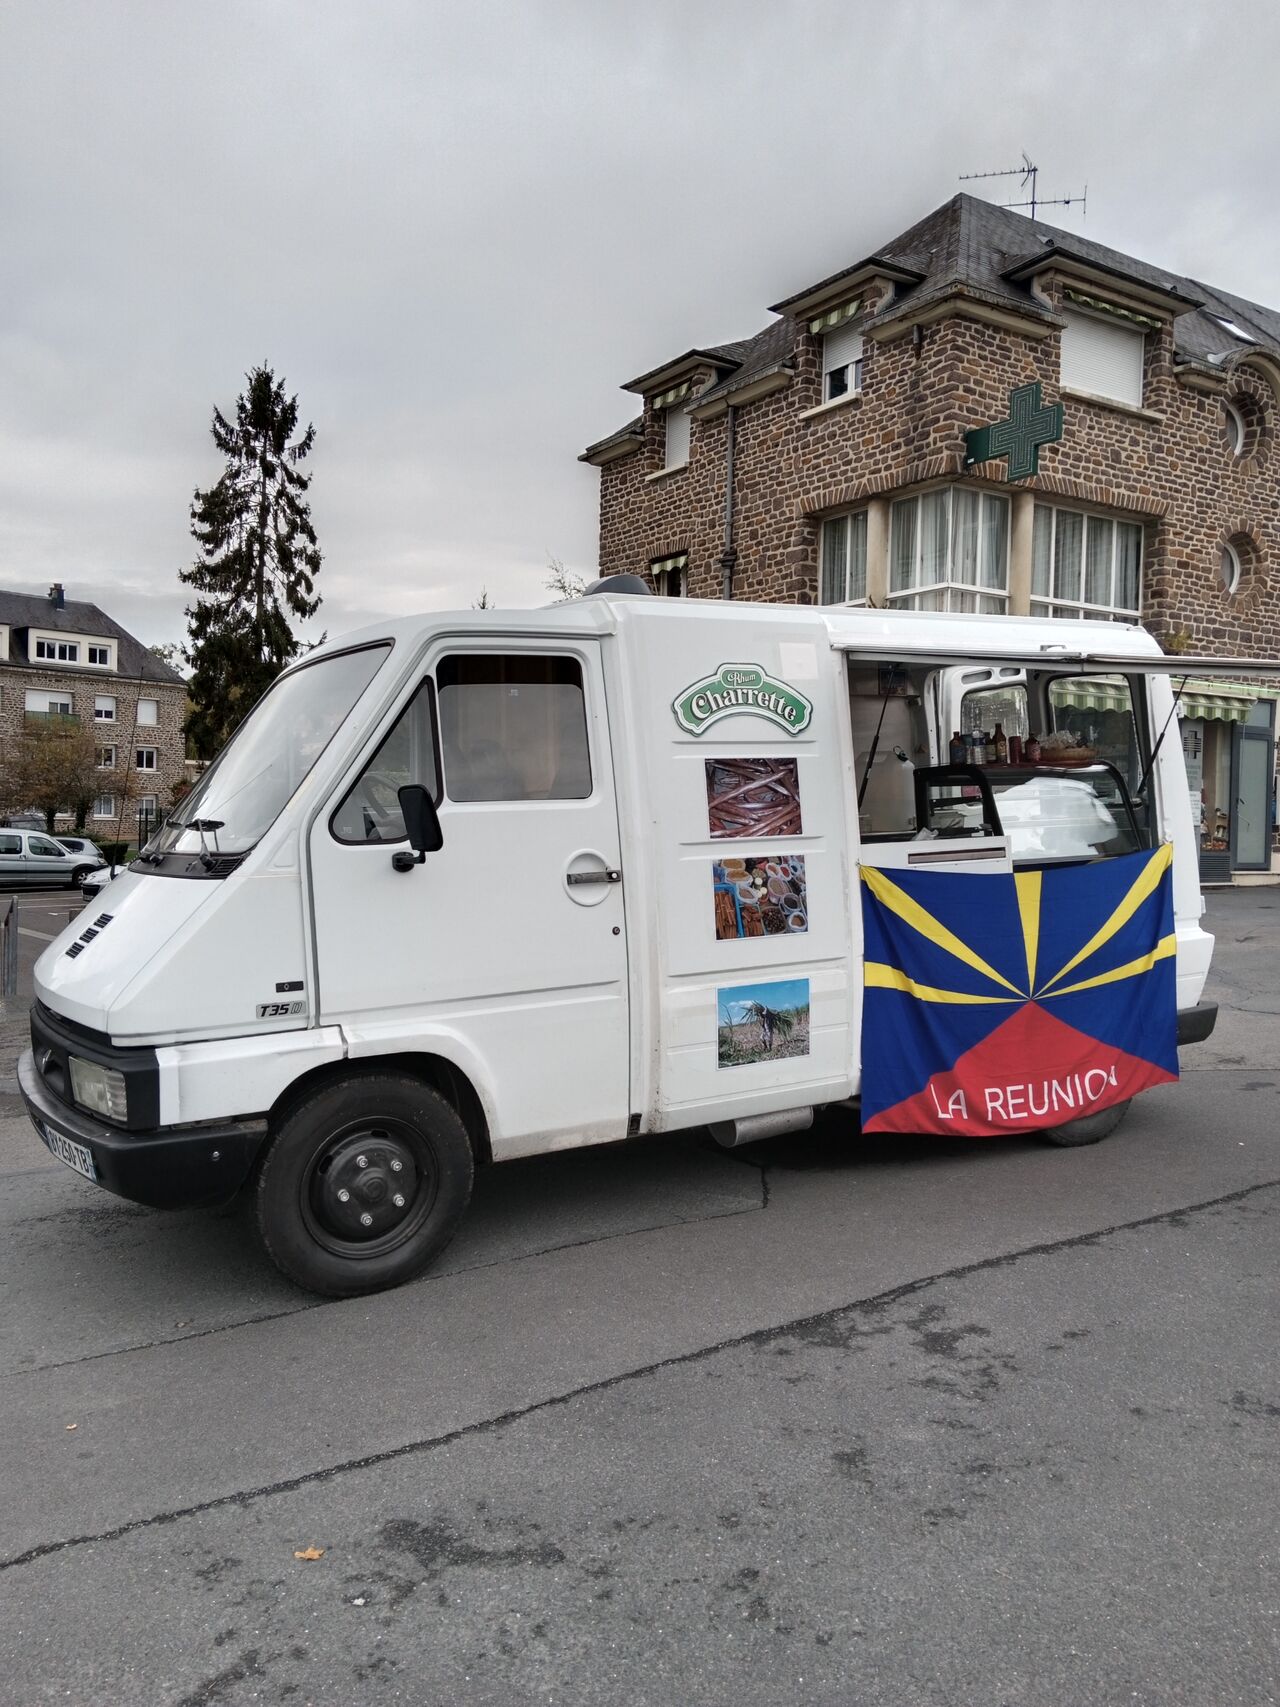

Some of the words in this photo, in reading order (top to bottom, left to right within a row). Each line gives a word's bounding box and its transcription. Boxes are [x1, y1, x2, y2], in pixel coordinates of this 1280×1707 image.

[727, 671, 756, 687] Rhum
[690, 687, 797, 721] Charrette
[930, 1083, 969, 1119] LA
